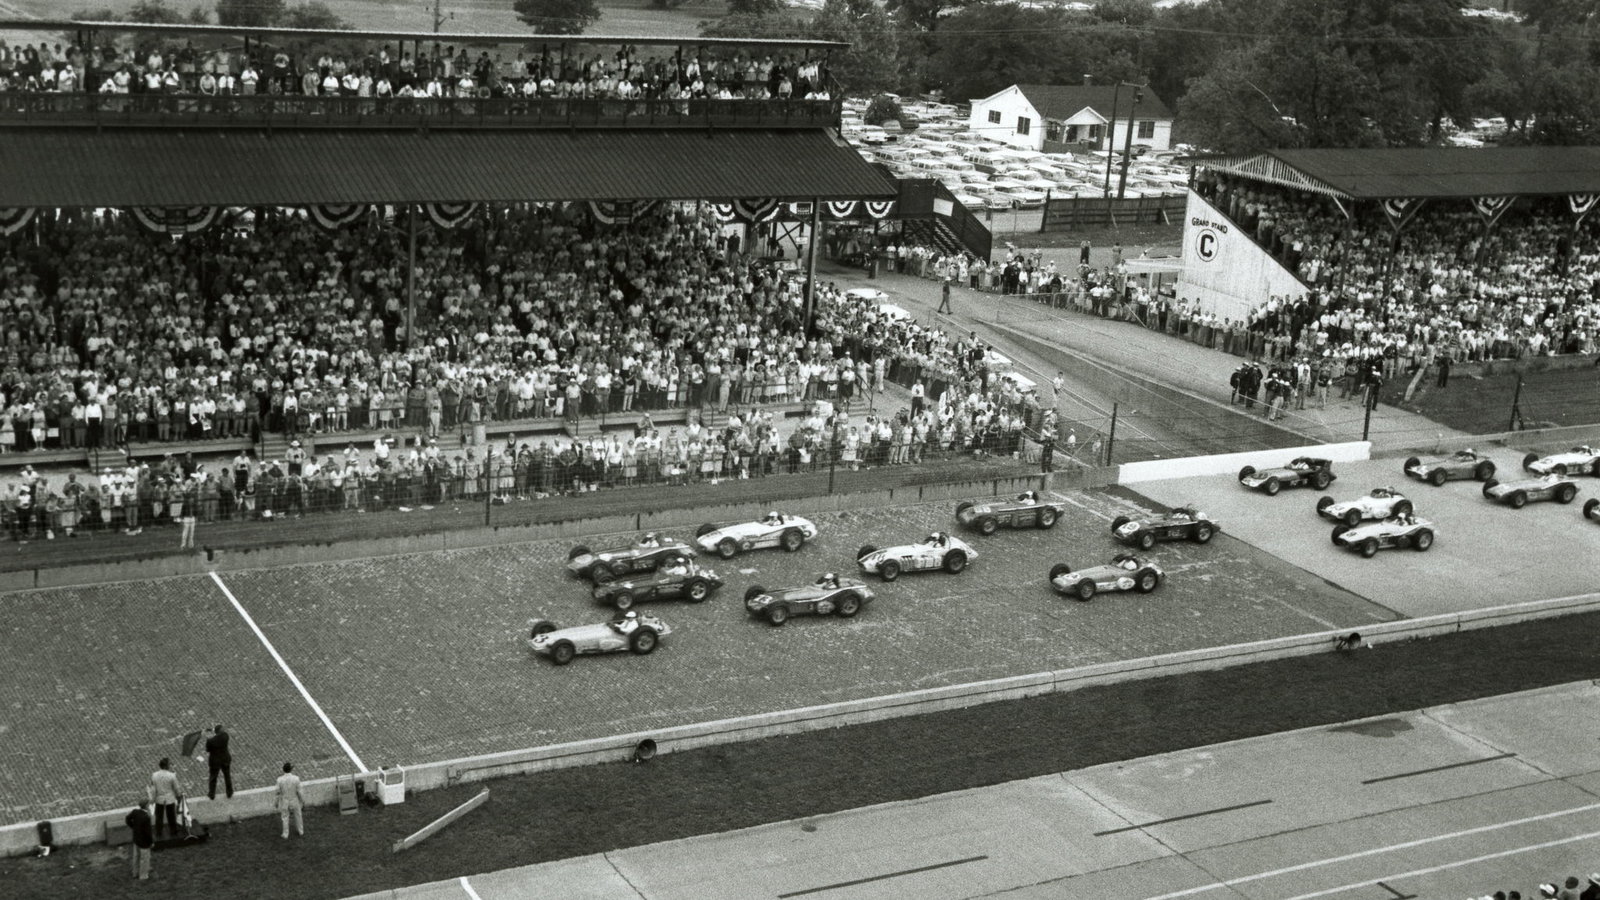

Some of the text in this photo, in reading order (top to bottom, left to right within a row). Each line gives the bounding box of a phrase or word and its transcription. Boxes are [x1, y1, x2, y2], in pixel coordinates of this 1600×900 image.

[1191, 217, 1228, 234] GRAND STAND
[1200, 234, 1214, 257] C
